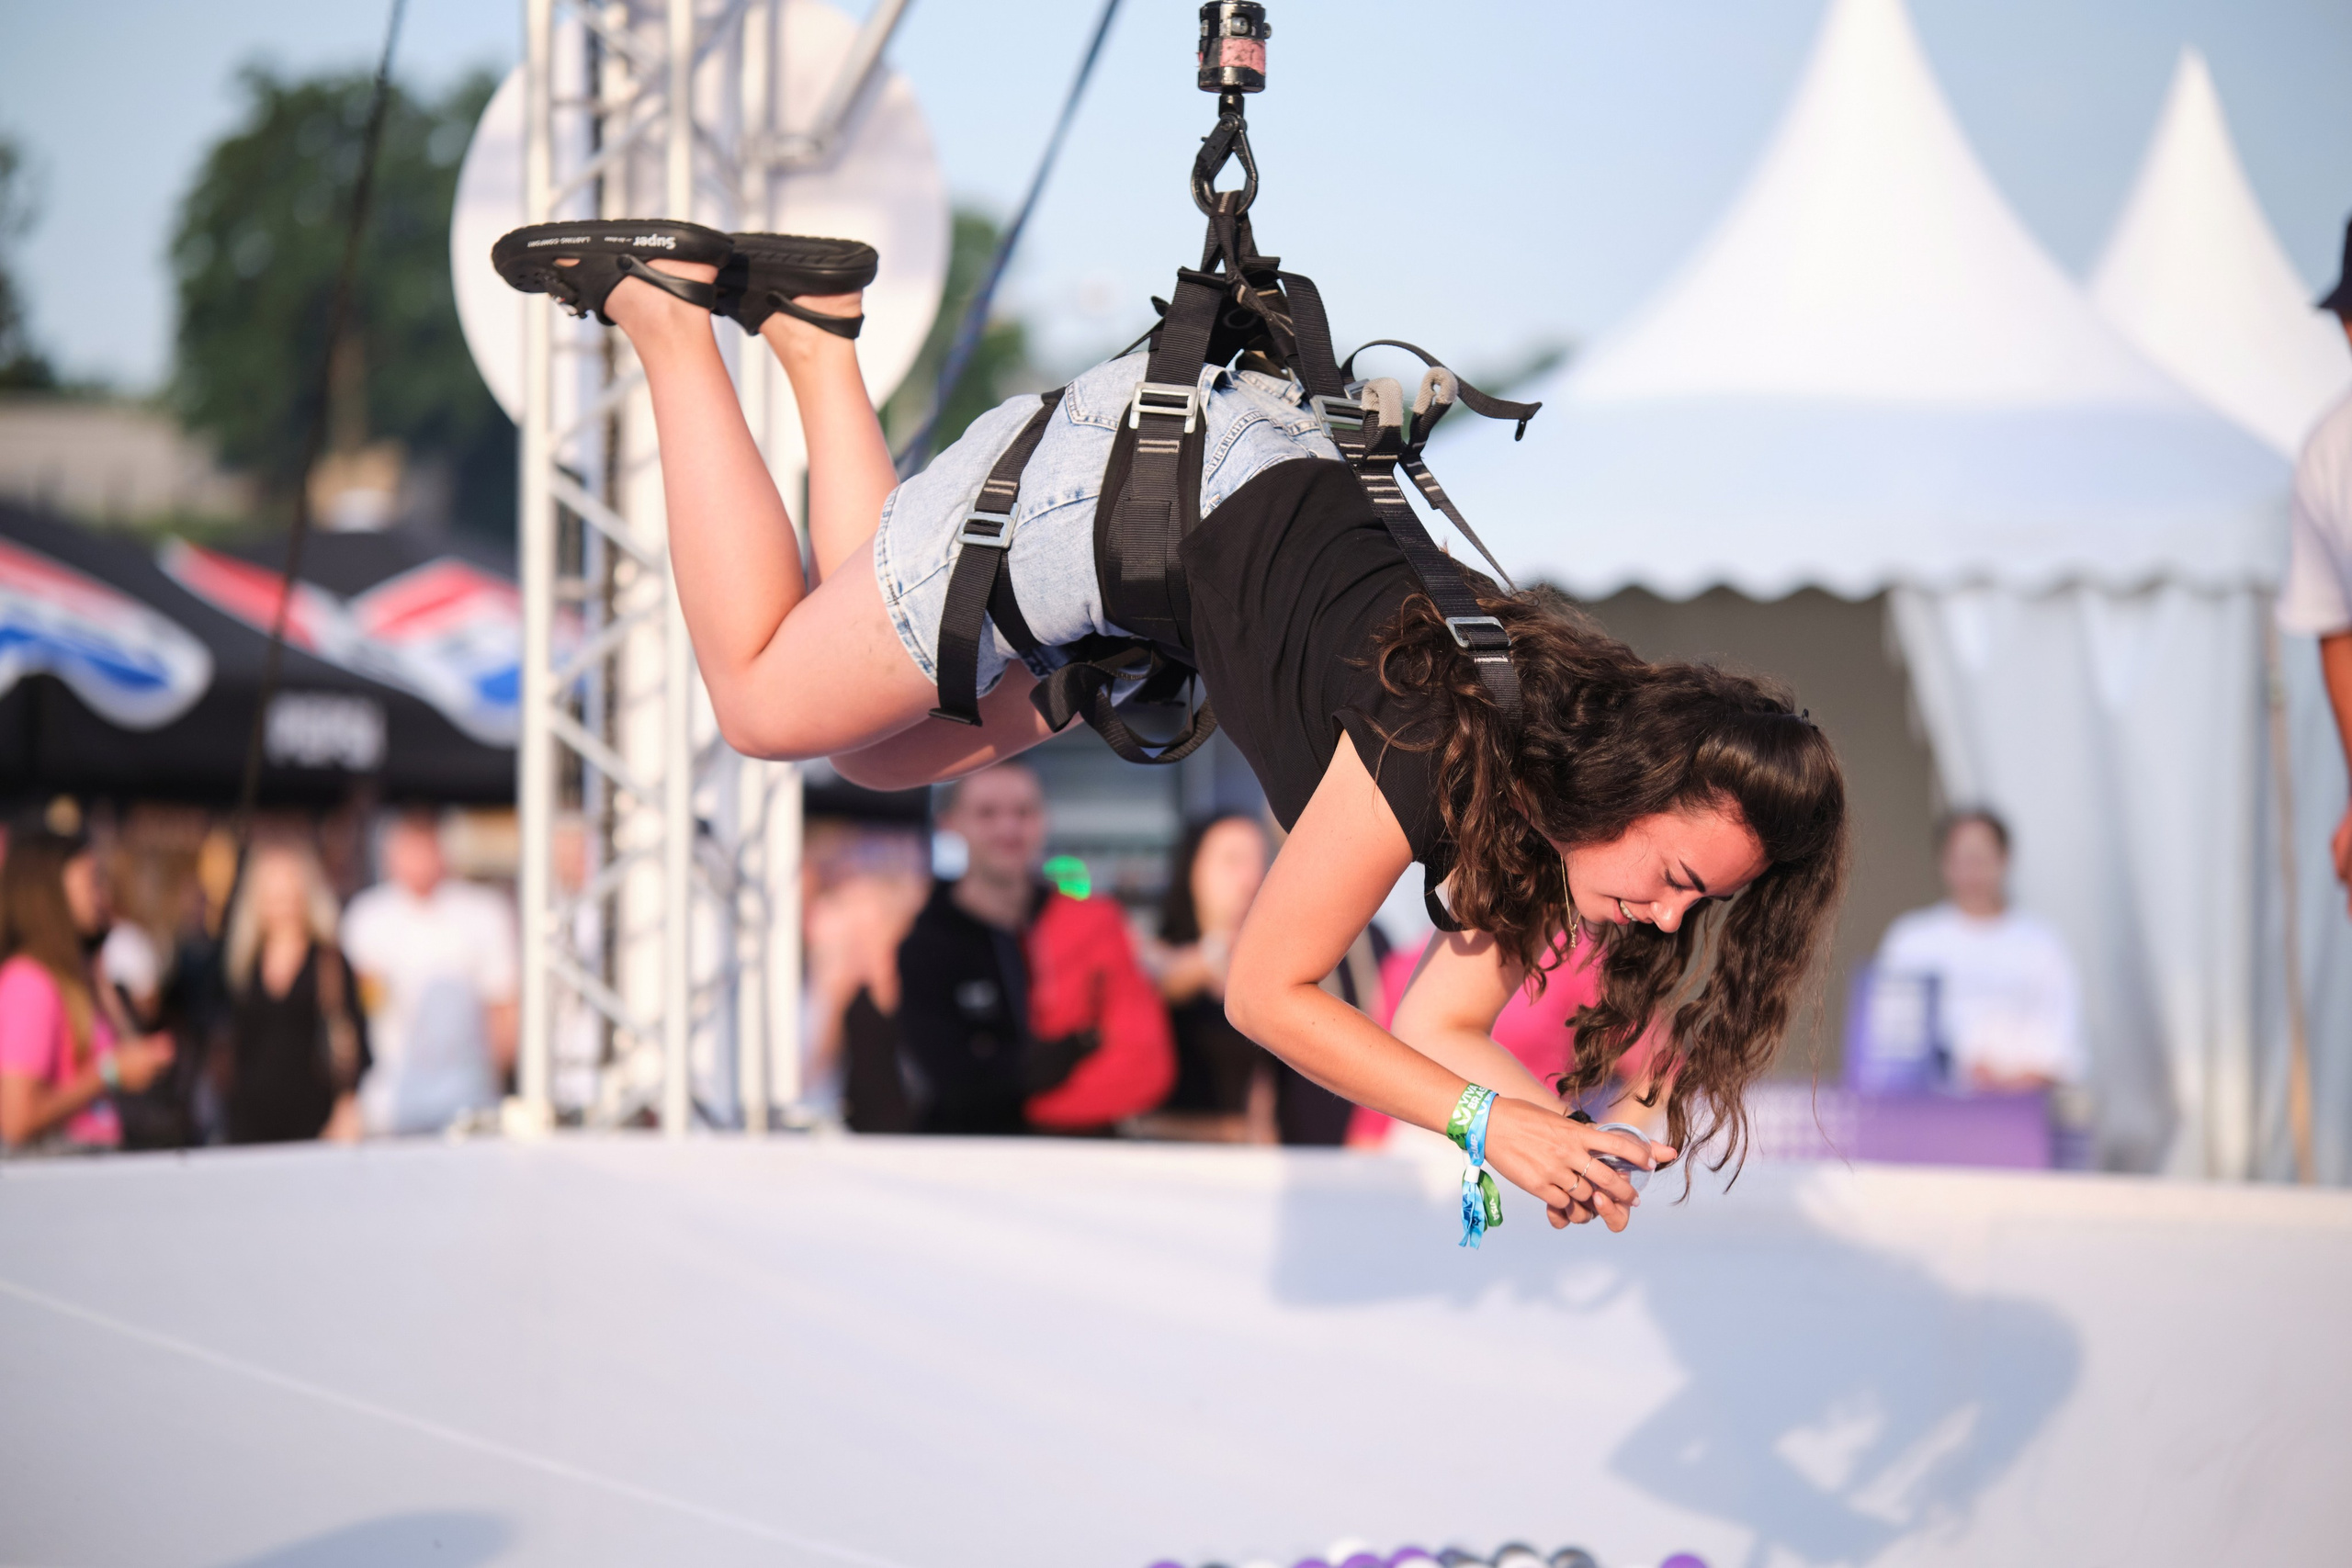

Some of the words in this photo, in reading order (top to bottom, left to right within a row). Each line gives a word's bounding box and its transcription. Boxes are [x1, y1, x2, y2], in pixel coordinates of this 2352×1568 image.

[632, 232, 676, 250] Super
[1459, 1084, 1479, 1104] VIVA
[1470, 1133, 1481, 1159] CAMP
